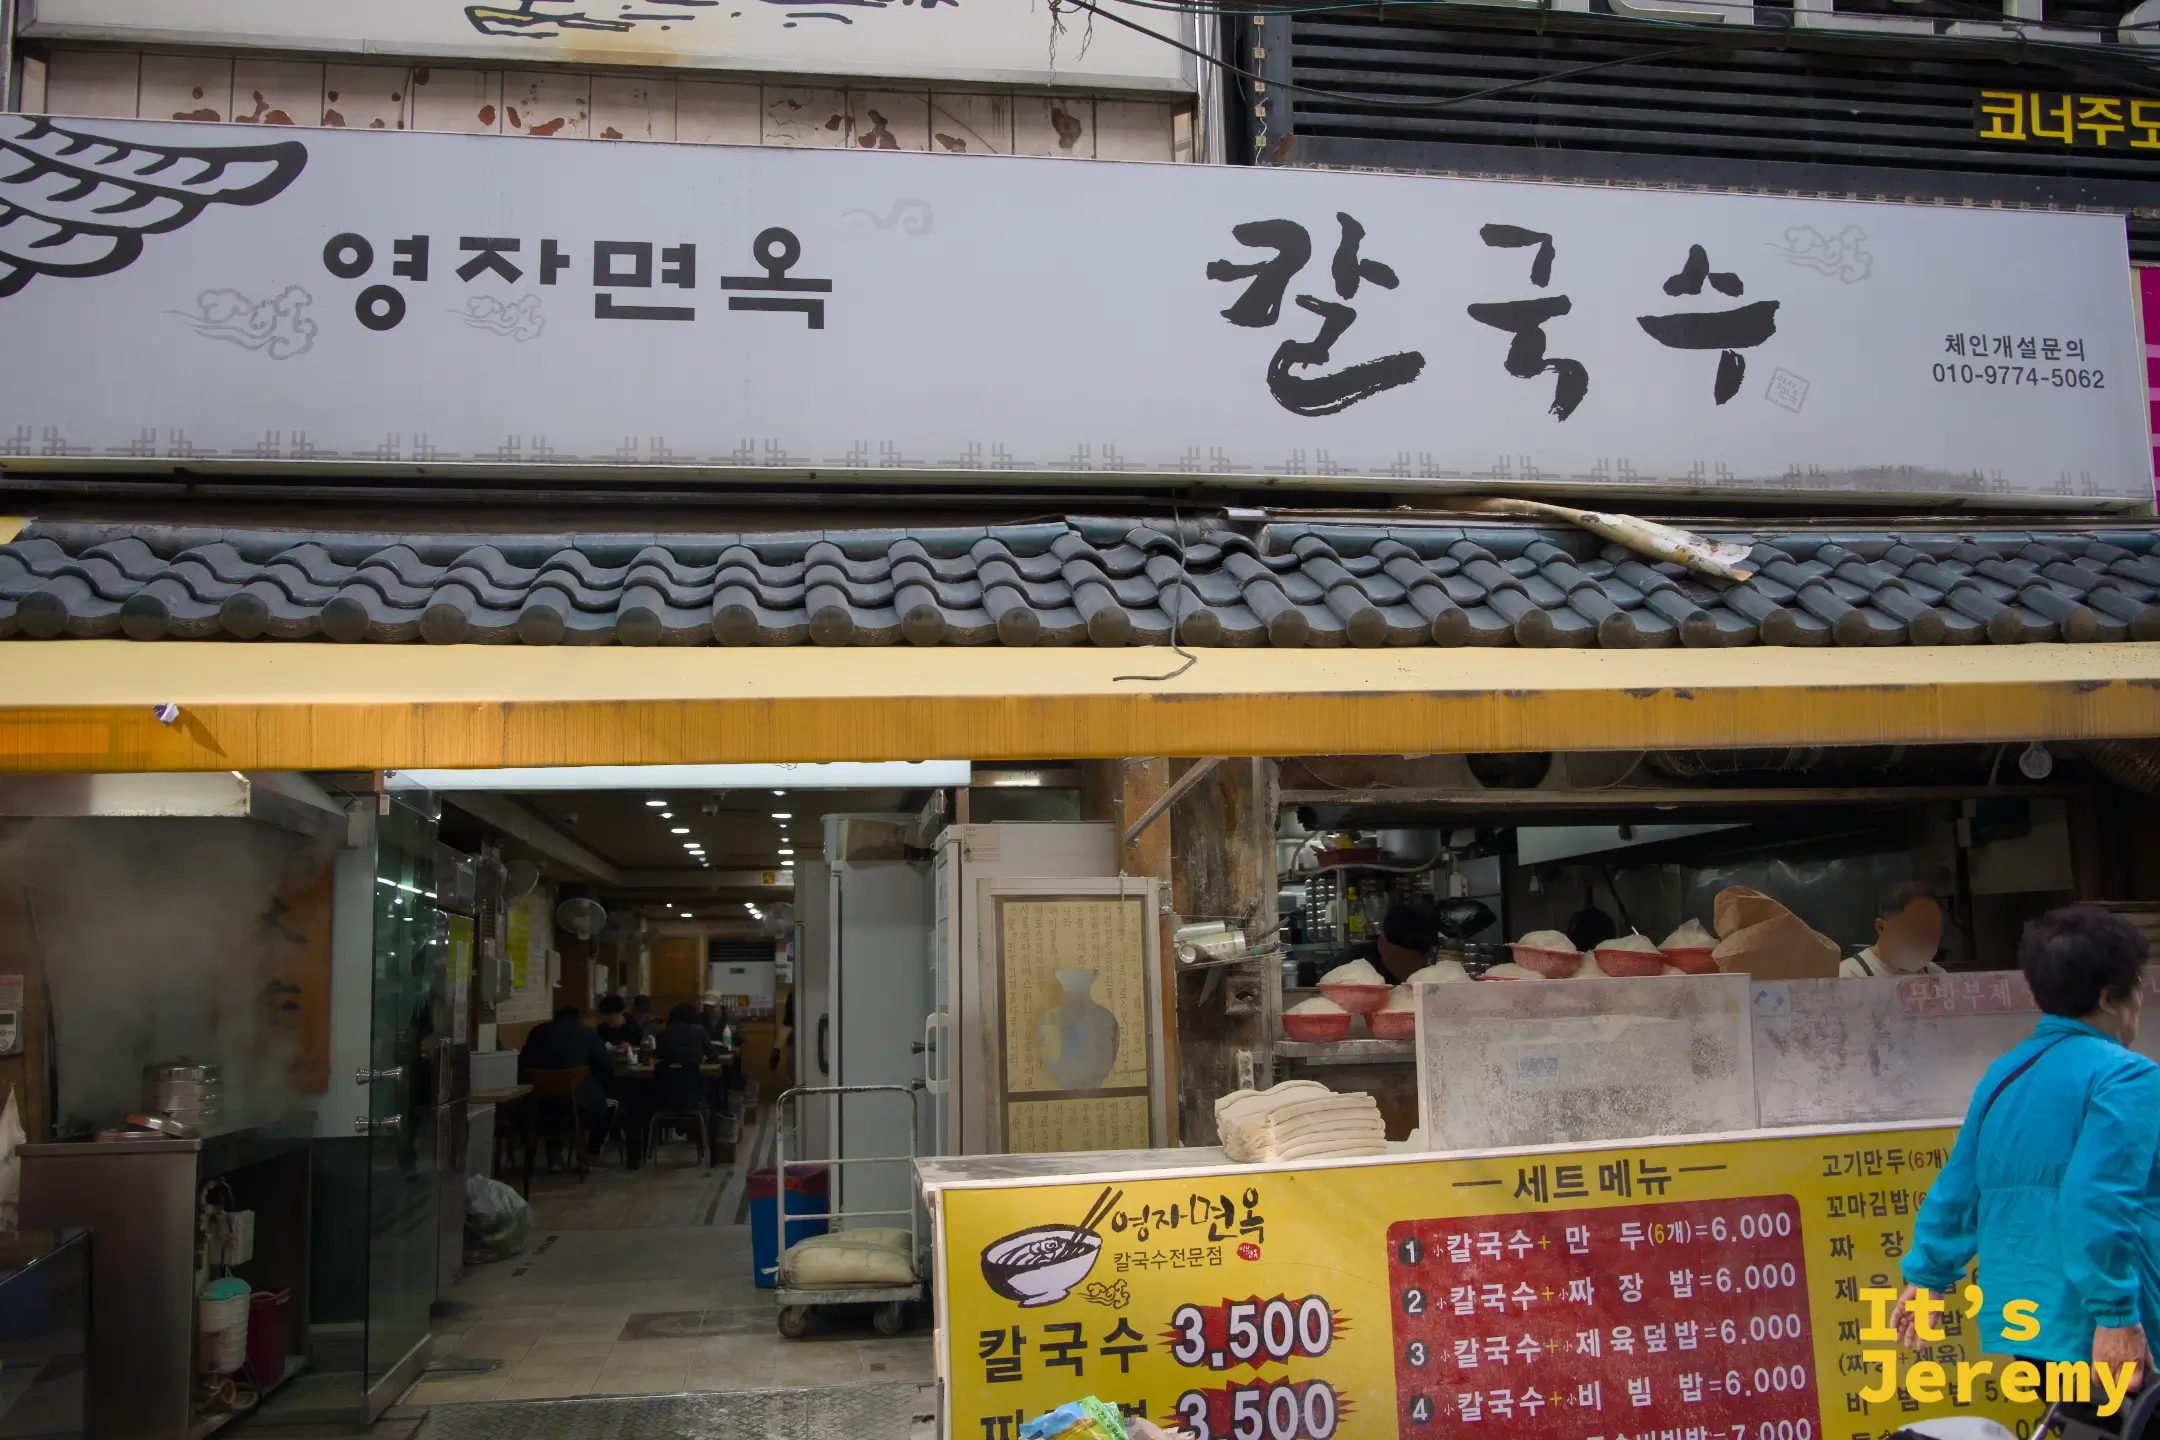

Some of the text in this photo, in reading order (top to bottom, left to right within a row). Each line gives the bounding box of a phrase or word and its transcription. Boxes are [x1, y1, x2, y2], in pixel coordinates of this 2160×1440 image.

[322, 226, 833, 332] 영자면옥
[1207, 211, 1781, 422] 칼국수
[1932, 363, 2106, 389] 010-9774-5062
[1113, 1246, 1222, 1272] 칼국수전문점
[1172, 1296, 1333, 1369] 3.500
